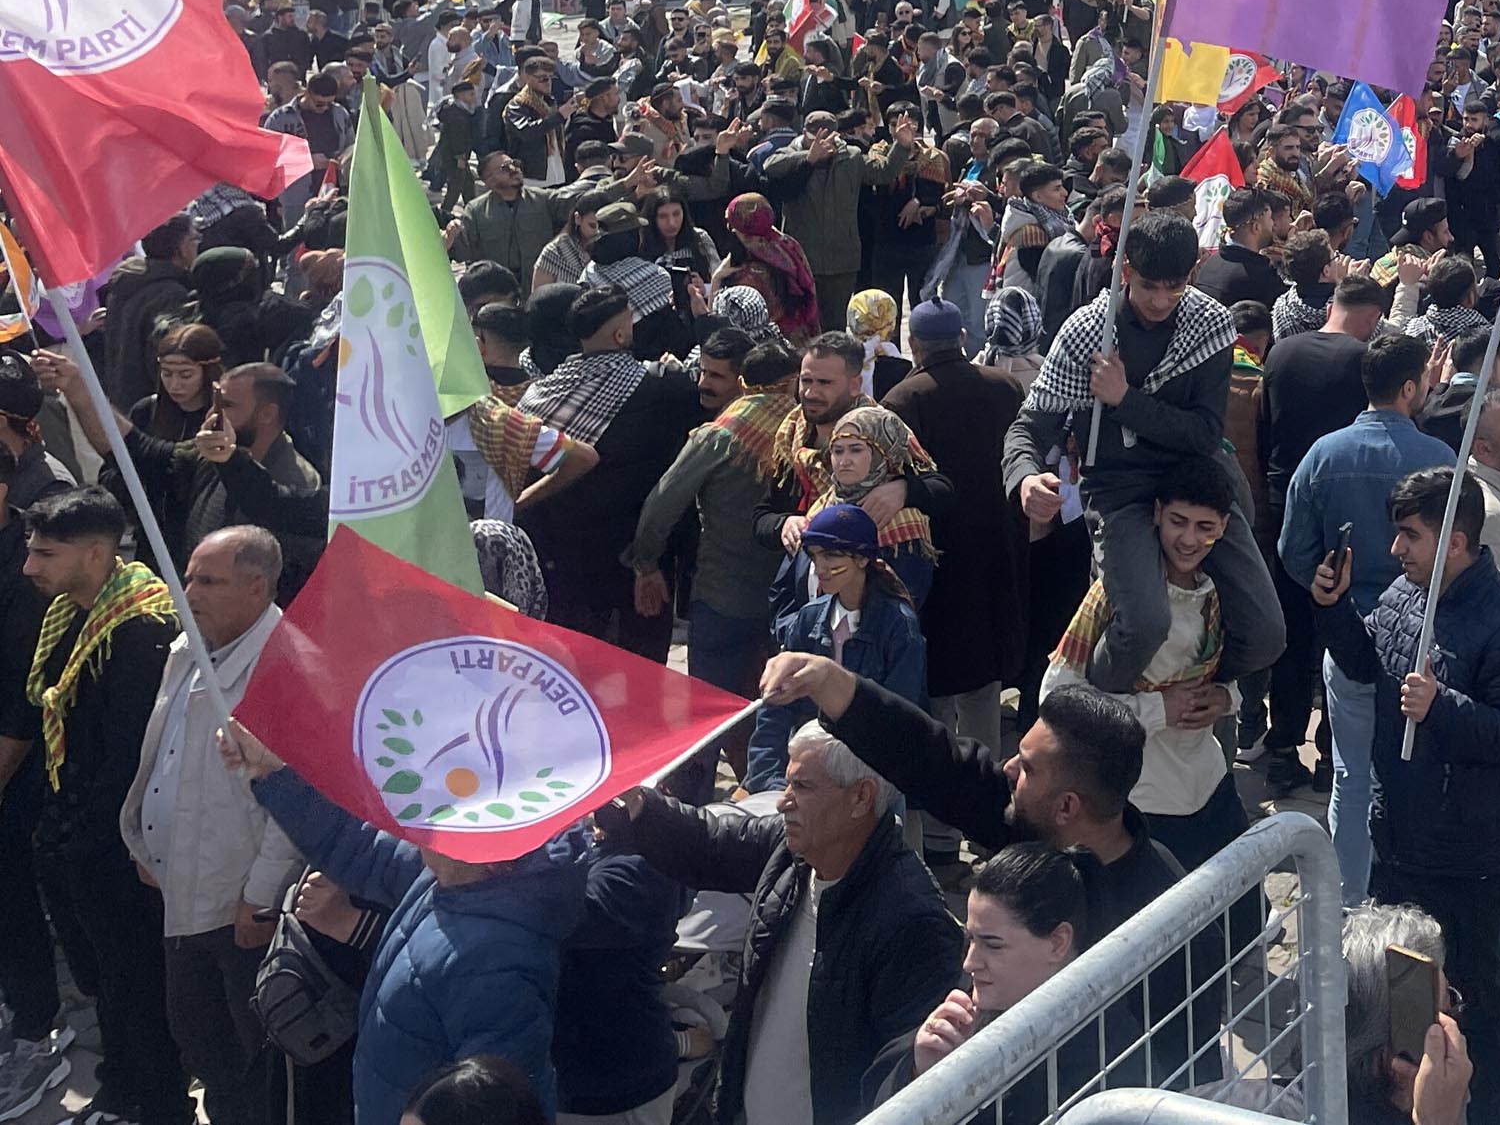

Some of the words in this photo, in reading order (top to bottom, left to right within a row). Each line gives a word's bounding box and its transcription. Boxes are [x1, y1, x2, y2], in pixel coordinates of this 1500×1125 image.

[0, 28, 47, 60] EM
[55, 9, 147, 61] PARTİ
[450, 648, 533, 681] PARTİ
[531, 669, 581, 716] DEM
